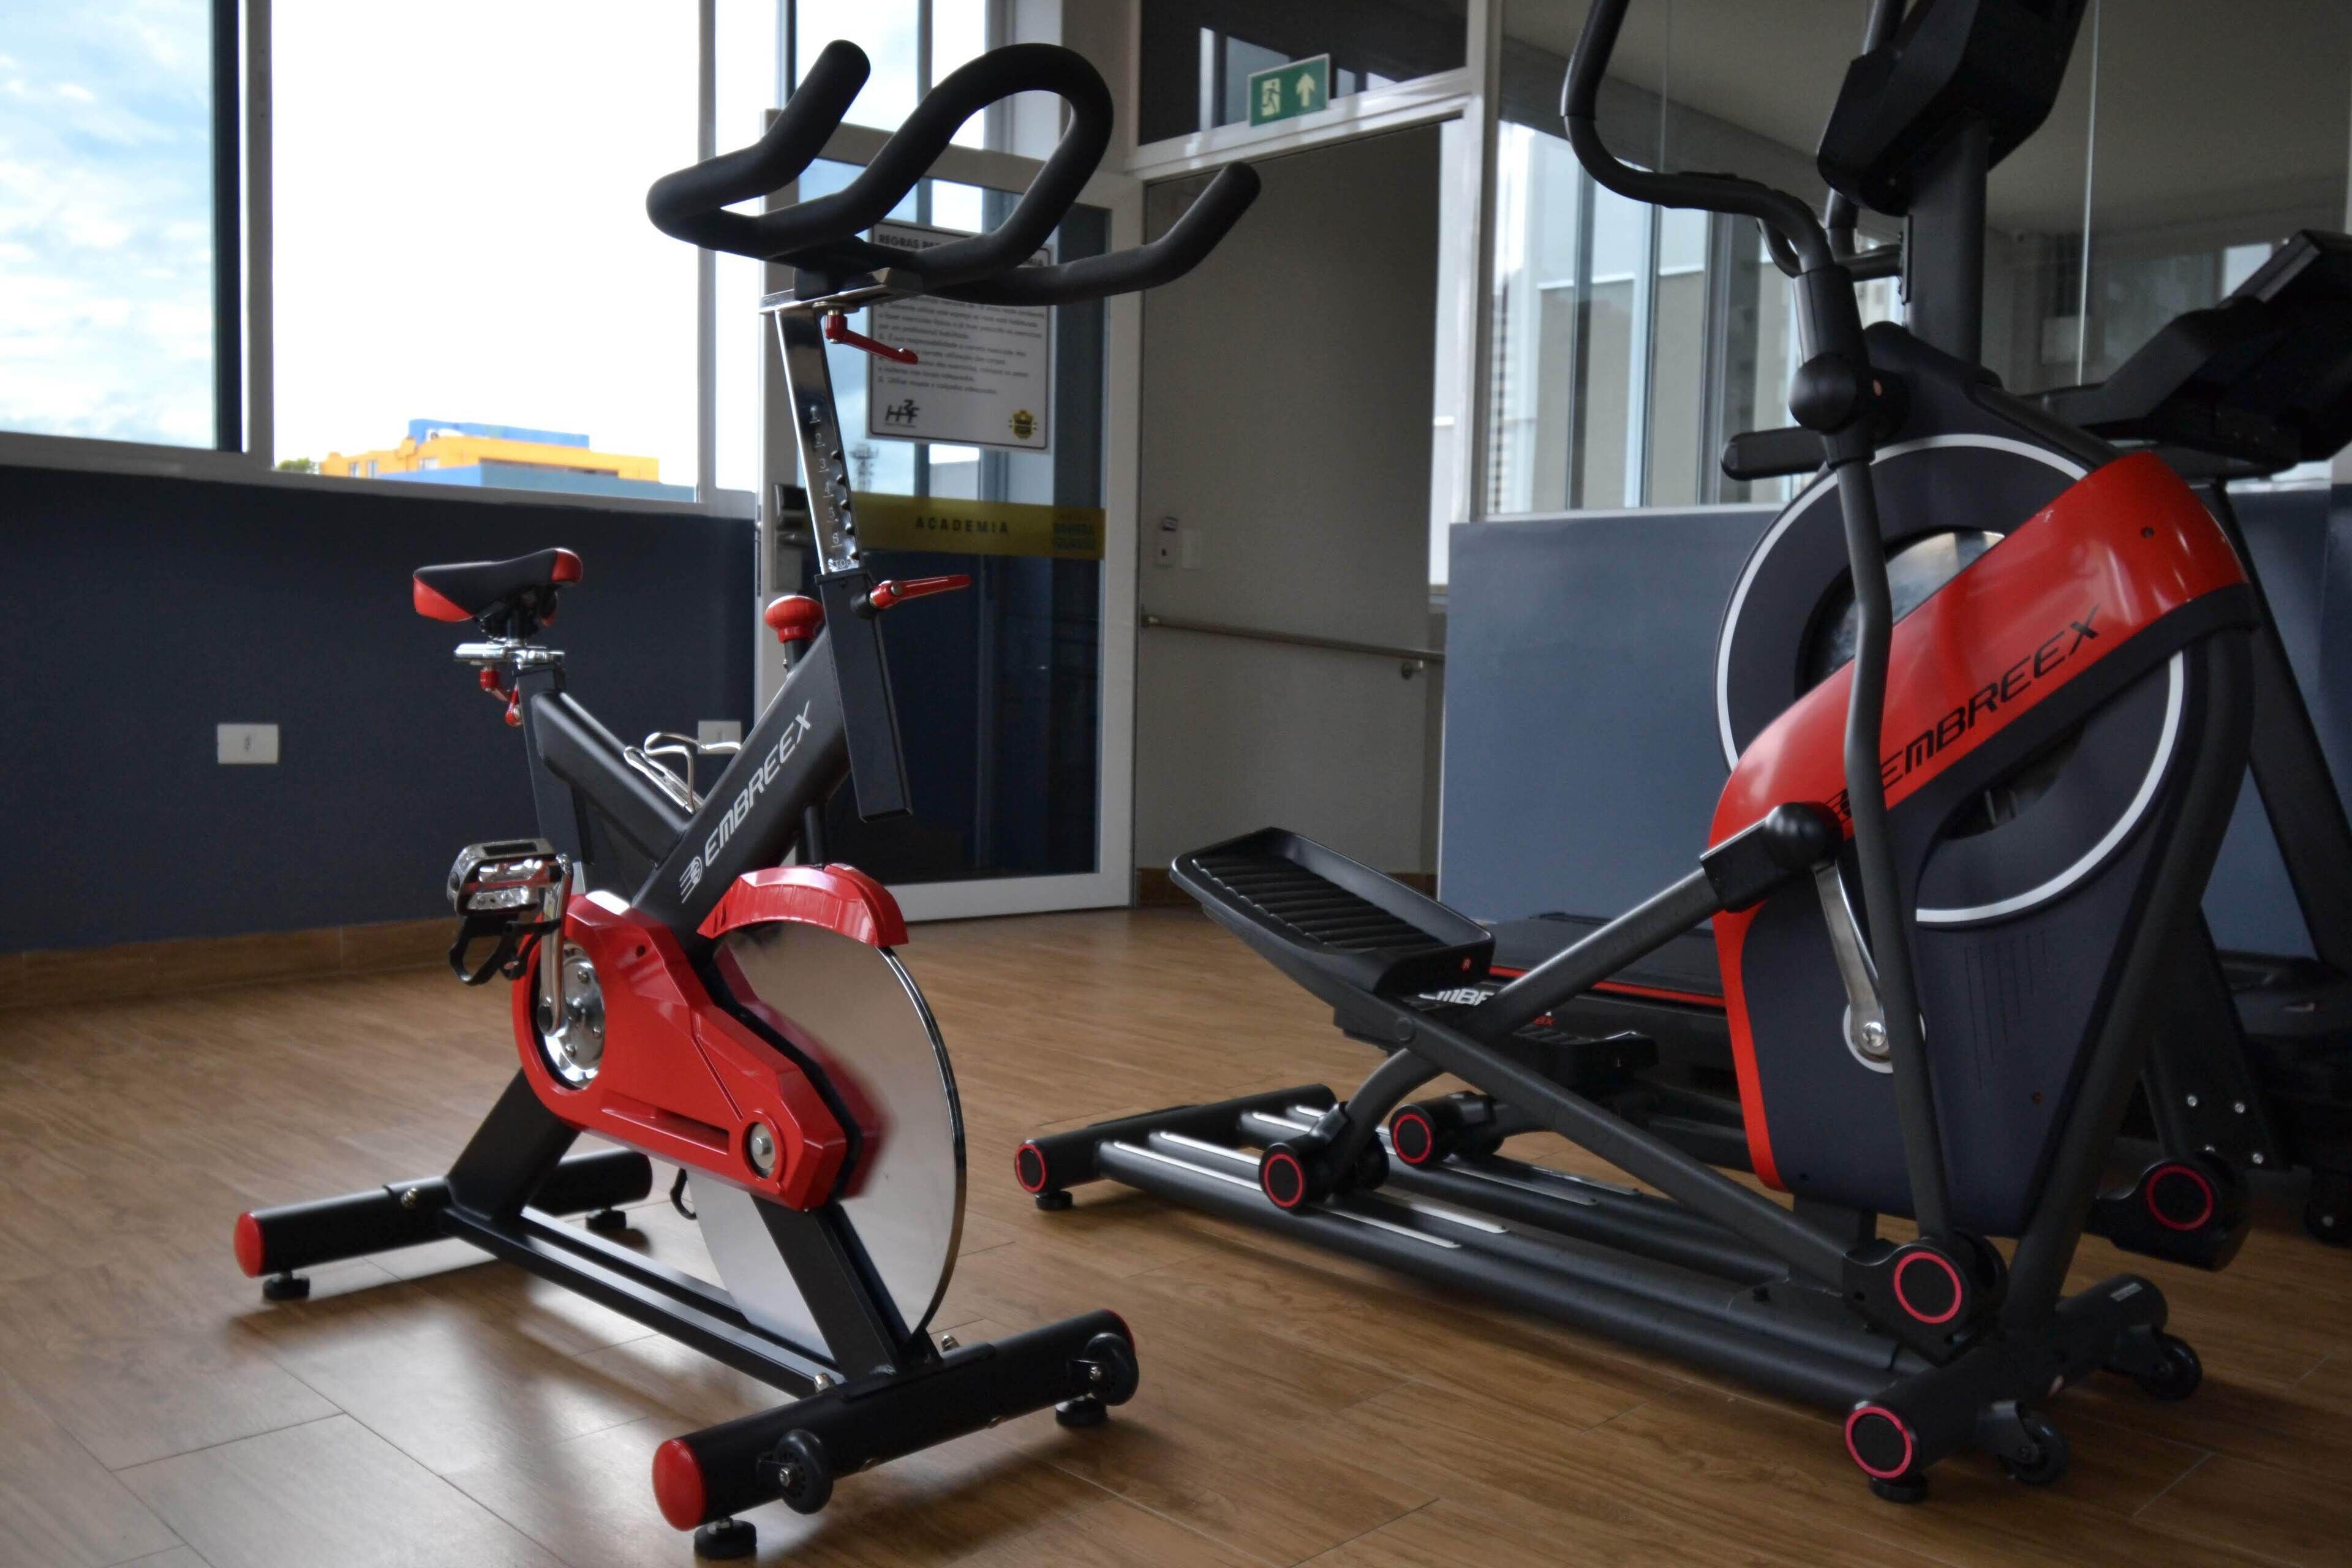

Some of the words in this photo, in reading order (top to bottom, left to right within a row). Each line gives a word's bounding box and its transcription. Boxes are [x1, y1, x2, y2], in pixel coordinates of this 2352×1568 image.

[820, 458, 826, 469] 3
[914, 516, 1009, 534] ACADEMIA
[1880, 604, 2100, 790] EMBREEX
[705, 700, 812, 867] EMBREEX
